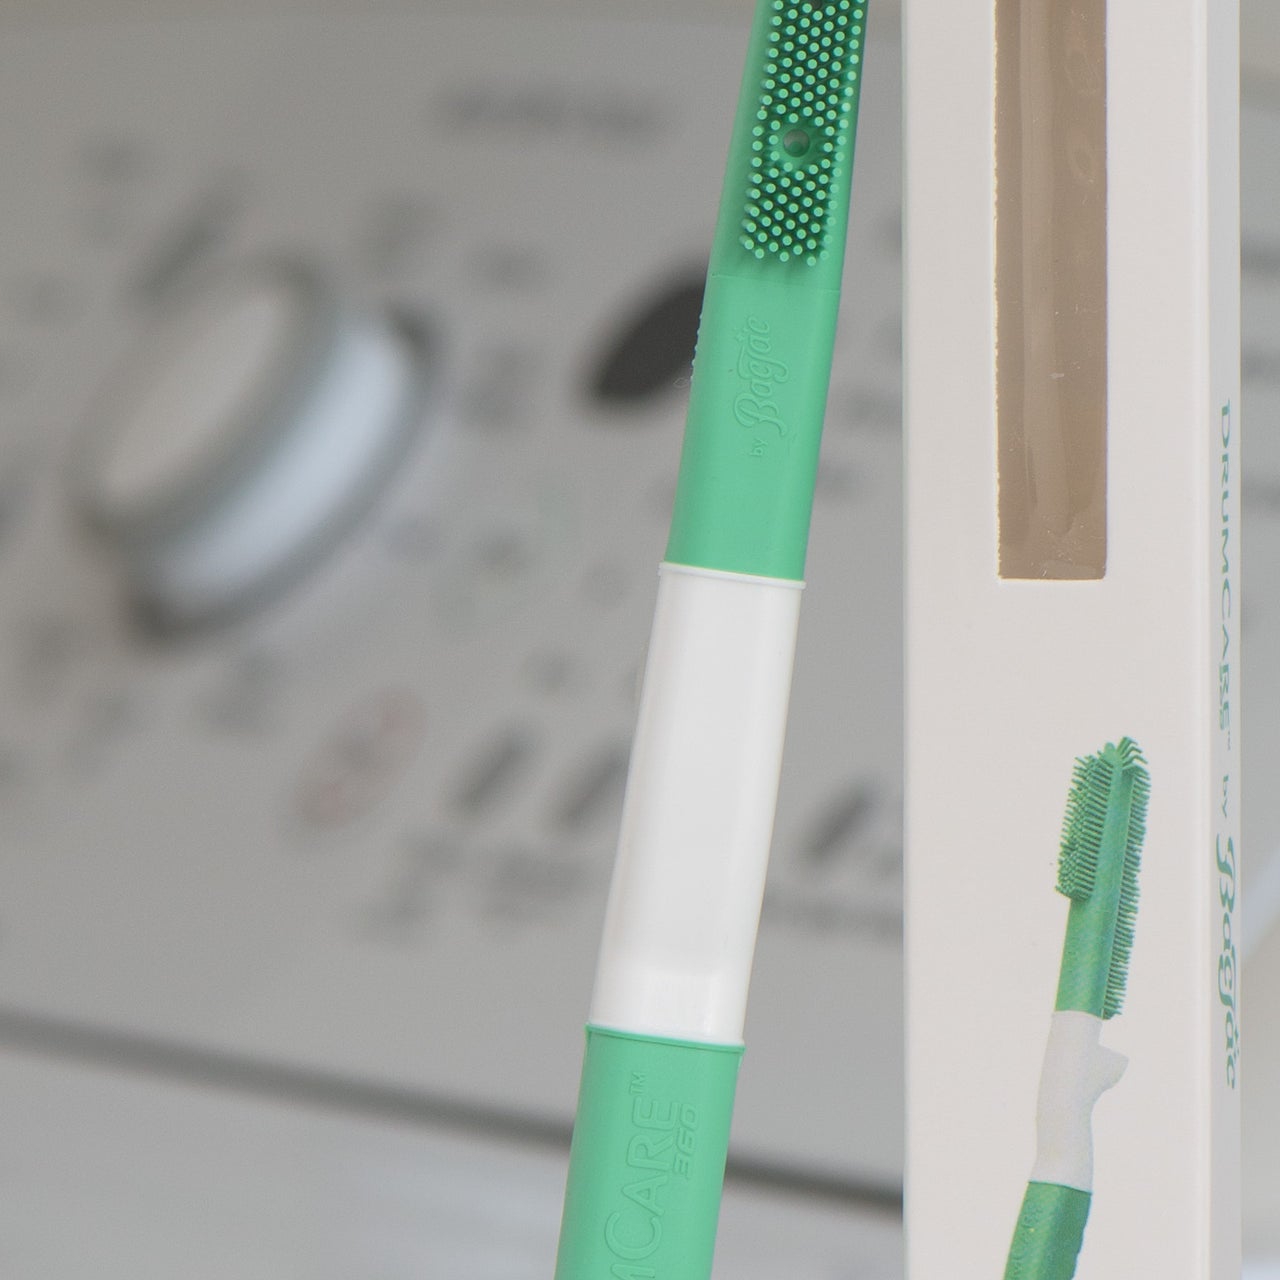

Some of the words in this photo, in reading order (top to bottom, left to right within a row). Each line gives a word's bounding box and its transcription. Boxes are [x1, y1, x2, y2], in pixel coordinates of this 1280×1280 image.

[749, 438, 767, 458] by
[1221, 774, 1229, 819] by
[672, 1104, 701, 1179] 360
